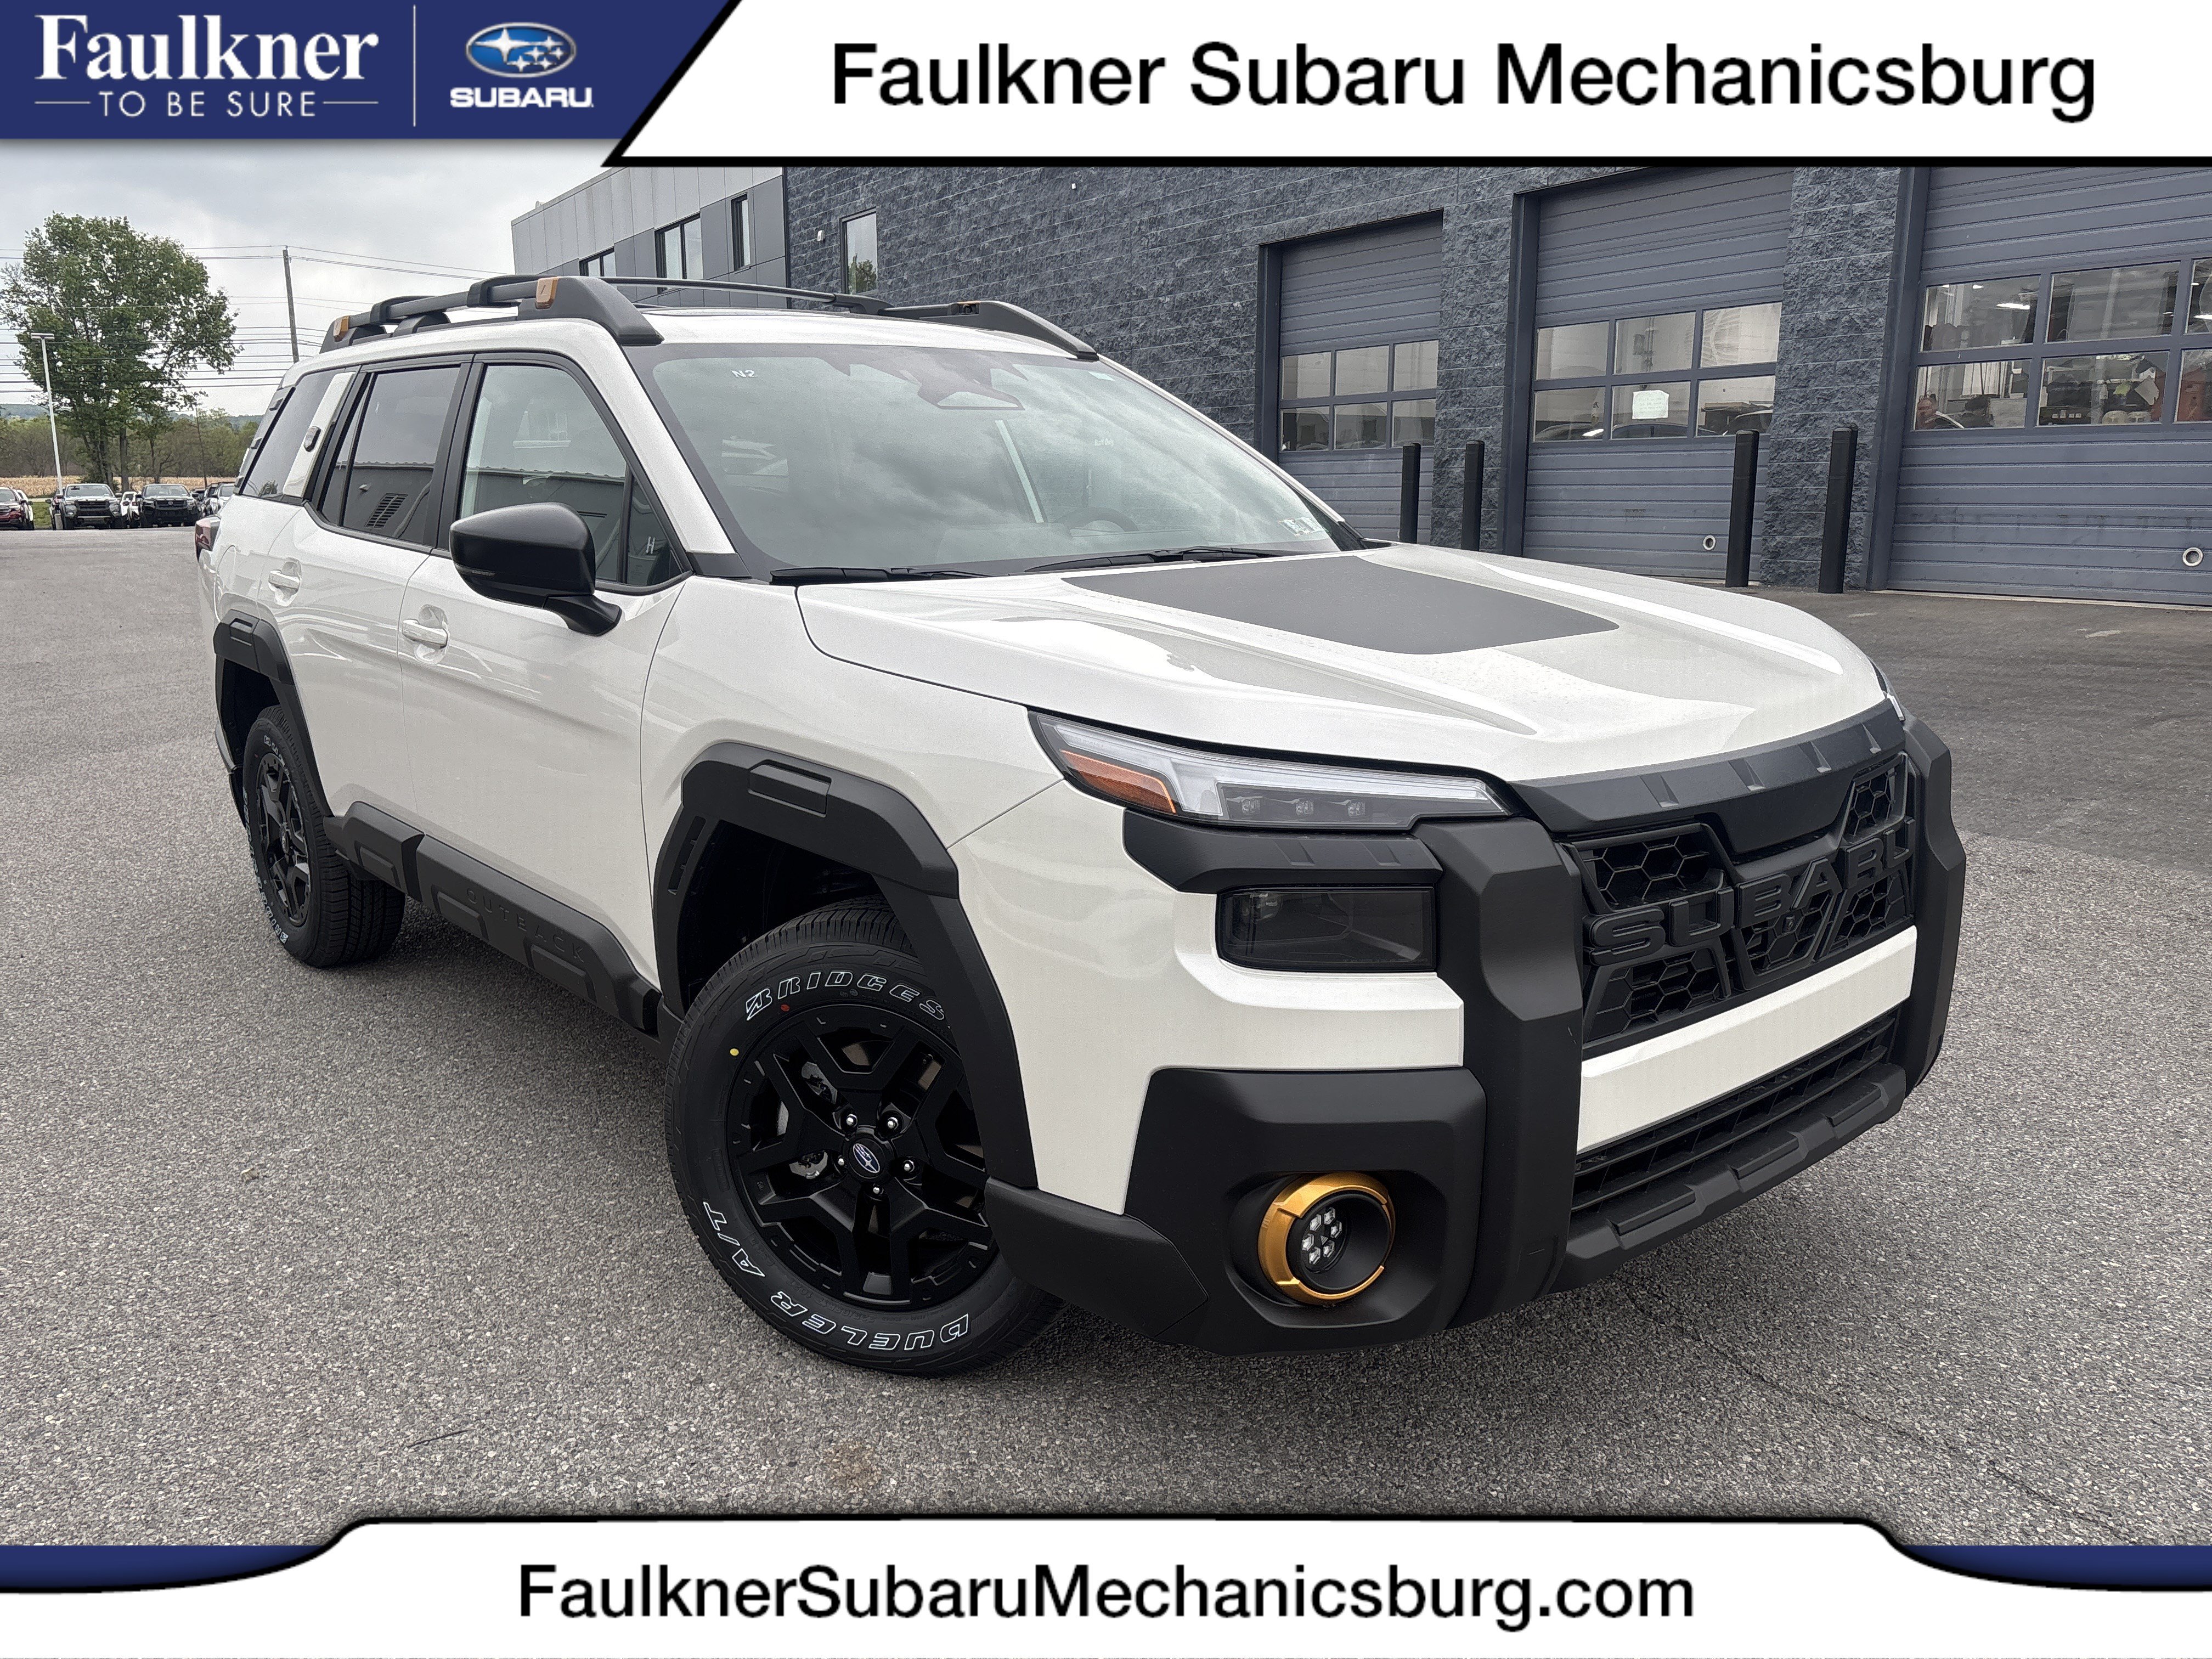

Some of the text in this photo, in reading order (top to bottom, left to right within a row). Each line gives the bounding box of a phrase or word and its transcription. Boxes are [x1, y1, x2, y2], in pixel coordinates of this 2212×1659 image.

[467, 888, 585, 963] OUTBACK
[1590, 819, 1916, 966] SUBARU
[746, 972, 945, 1020] BRIDGES
[703, 1201, 765, 1277] A/T
[771, 1291, 969, 1351] DUELER
